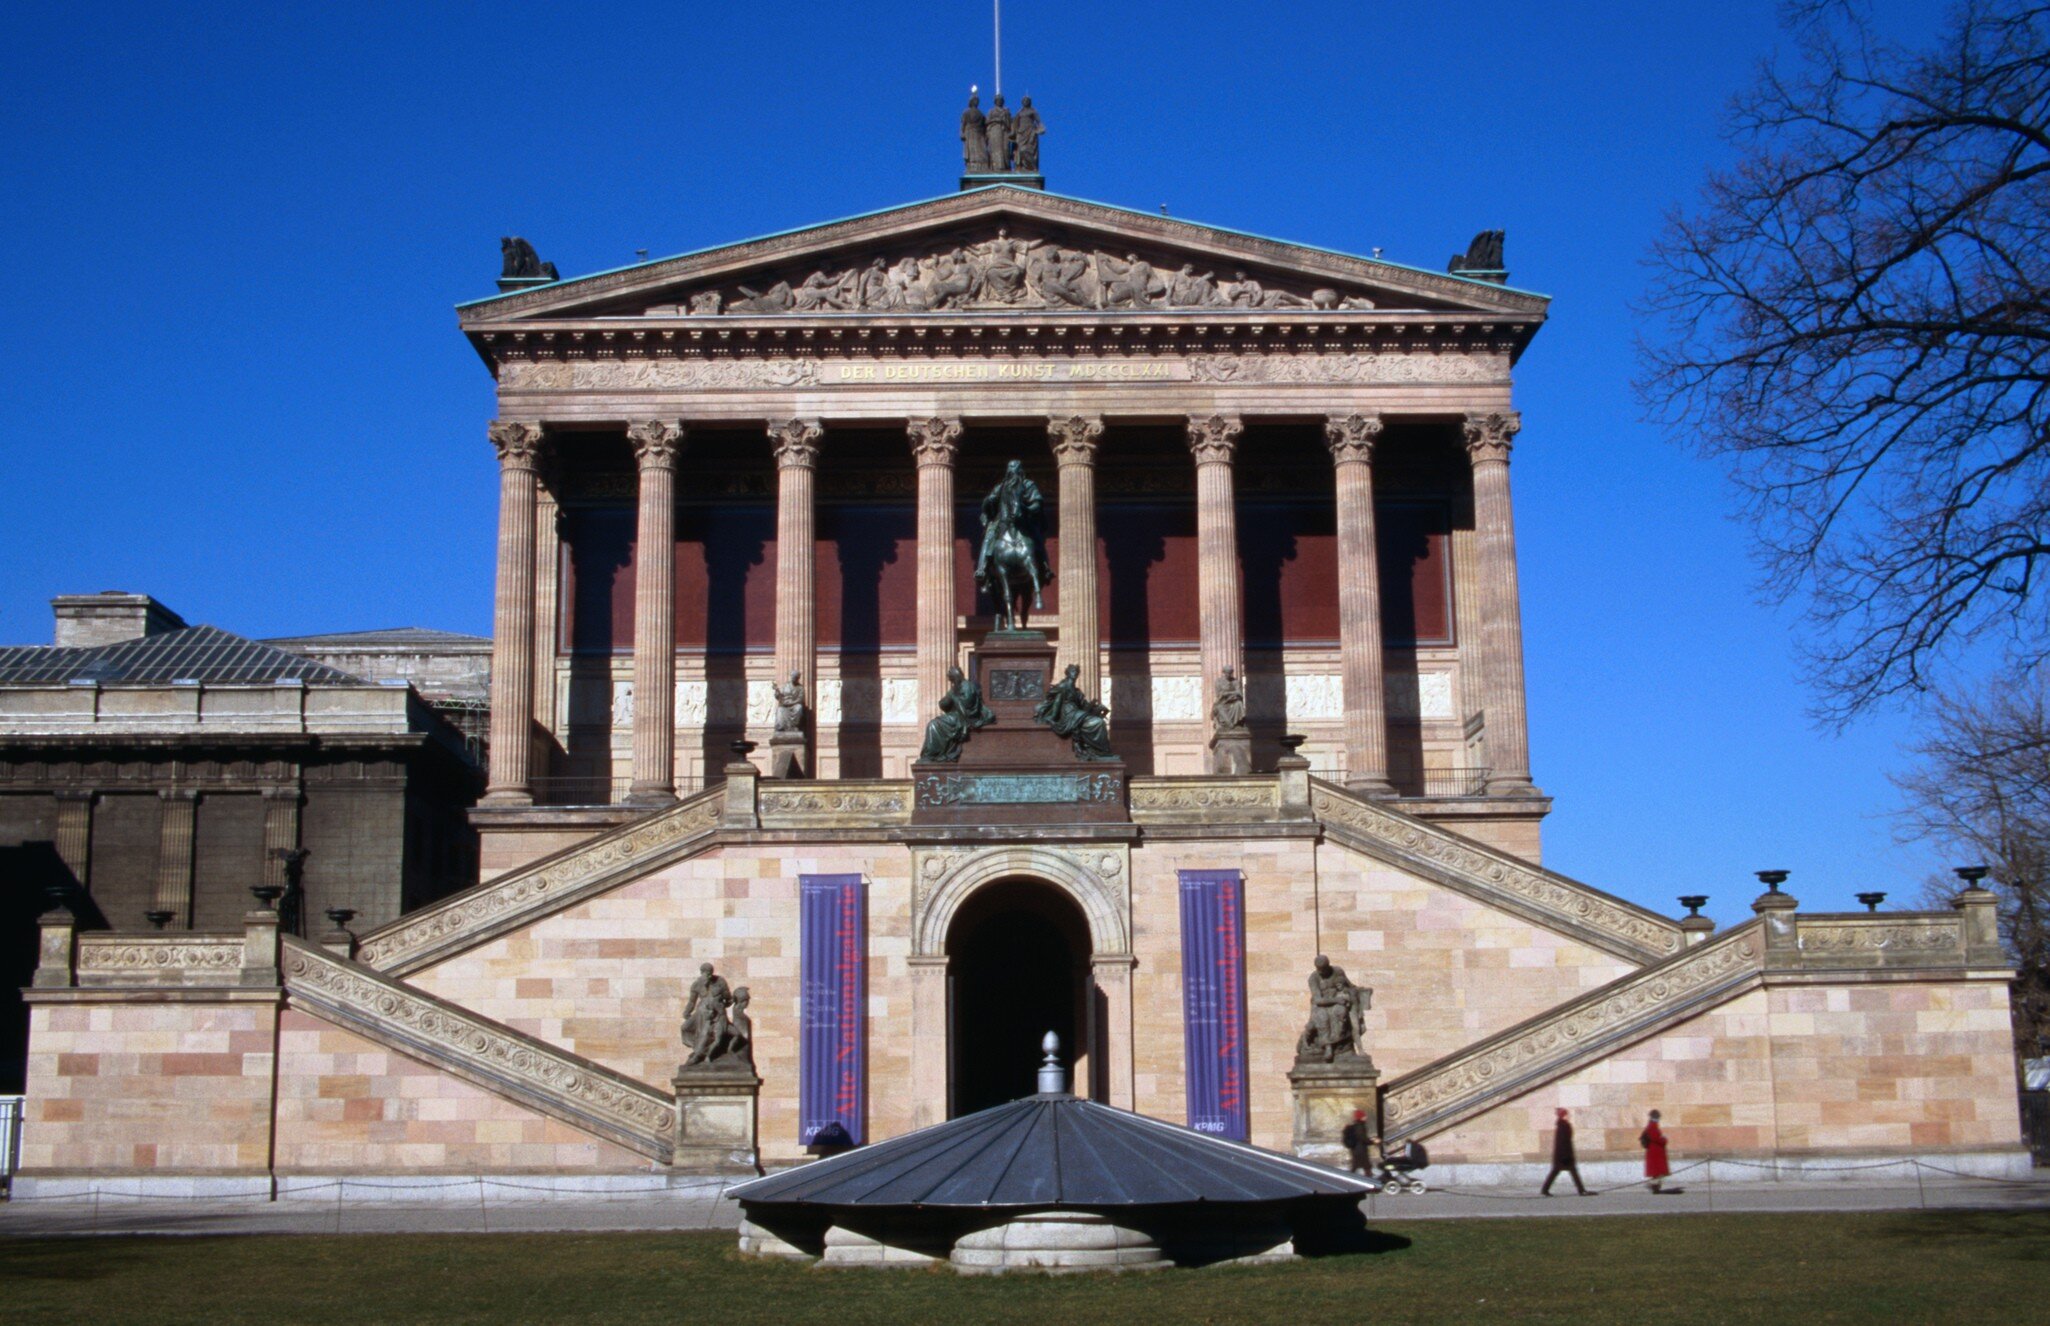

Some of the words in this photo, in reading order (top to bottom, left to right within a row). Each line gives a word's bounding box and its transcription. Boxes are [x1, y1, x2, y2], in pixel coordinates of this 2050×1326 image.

[841, 364, 875, 379] DER
[885, 364, 989, 379] DEUTSCHEN
[998, 363, 1056, 378] KUNST
[1069, 362, 1170, 378] MDCCCLXXI
[835, 884, 861, 1064] Nationalgalerie
[1215, 880, 1240, 1058] Nationalgalerie
[836, 1069, 857, 1118] Alte
[1220, 1065, 1241, 1114] Alte
[1193, 1121, 1225, 1132] KPMG
